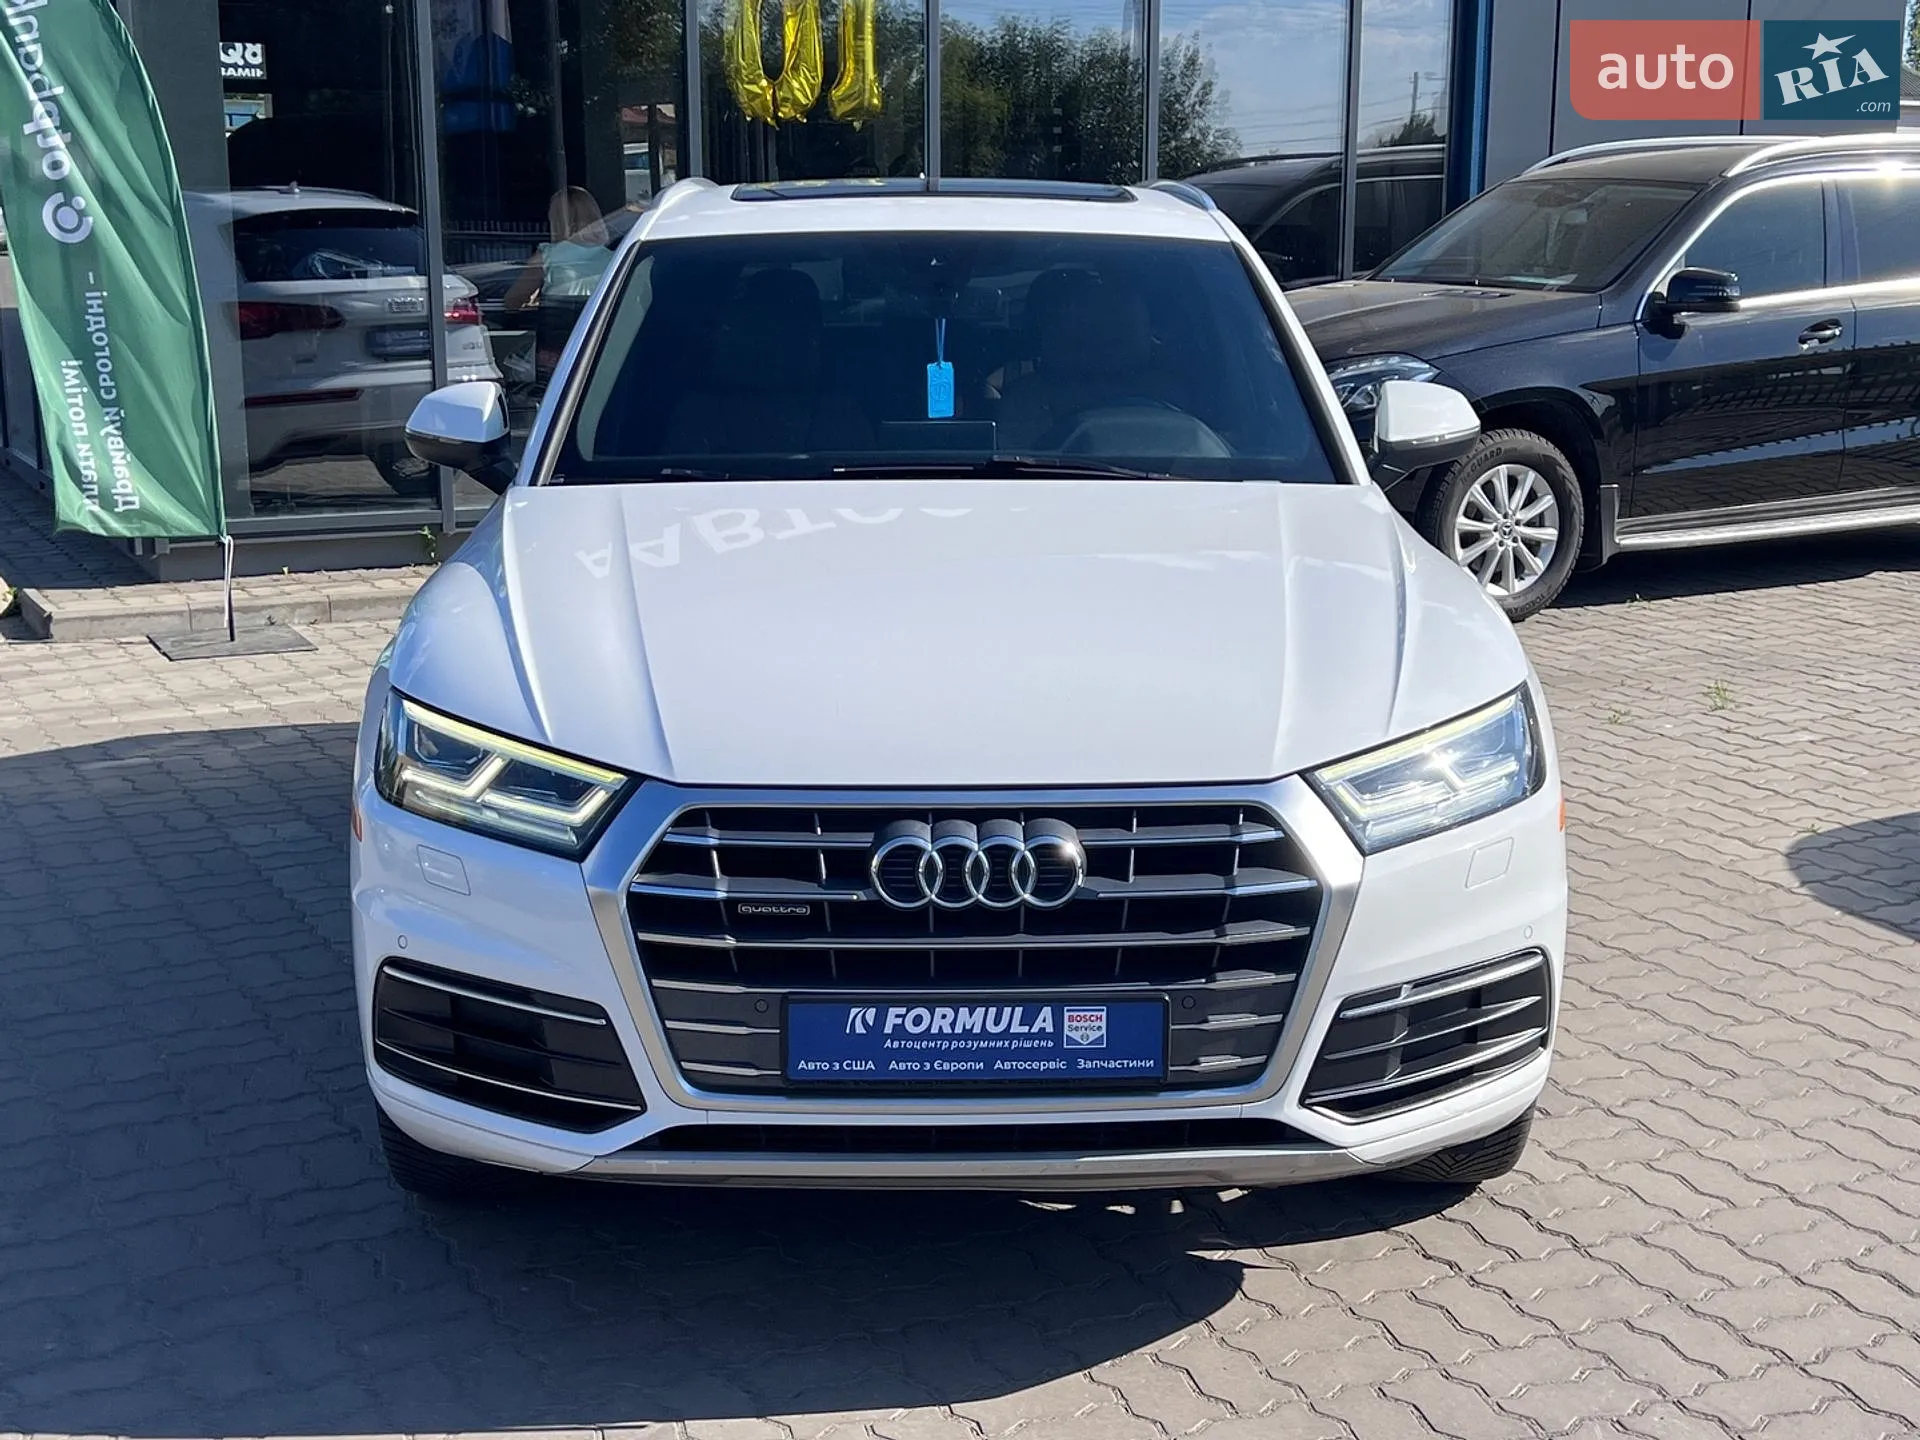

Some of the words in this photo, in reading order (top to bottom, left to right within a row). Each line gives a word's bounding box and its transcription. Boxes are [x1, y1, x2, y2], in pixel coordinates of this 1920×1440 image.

[741, 905, 807, 914] quattro
[883, 1006, 1054, 1034] FORMULA
[1067, 1014, 1103, 1023] BOSCH
[1067, 1024, 1103, 1032] Service
[883, 1038, 949, 1050] Автоцентр
[950, 1039, 1010, 1050] розумних
[1011, 1037, 1054, 1050] рішень
[798, 1060, 830, 1070] Авто
[832, 1062, 840, 1070] з
[842, 1060, 876, 1070] США
[888, 1060, 920, 1070] Авто
[923, 1061, 931, 1070] з
[934, 1059, 984, 1072] Європи
[994, 1058, 1067, 1071] Автосервіс
[1076, 1058, 1154, 1069] Запчастини
